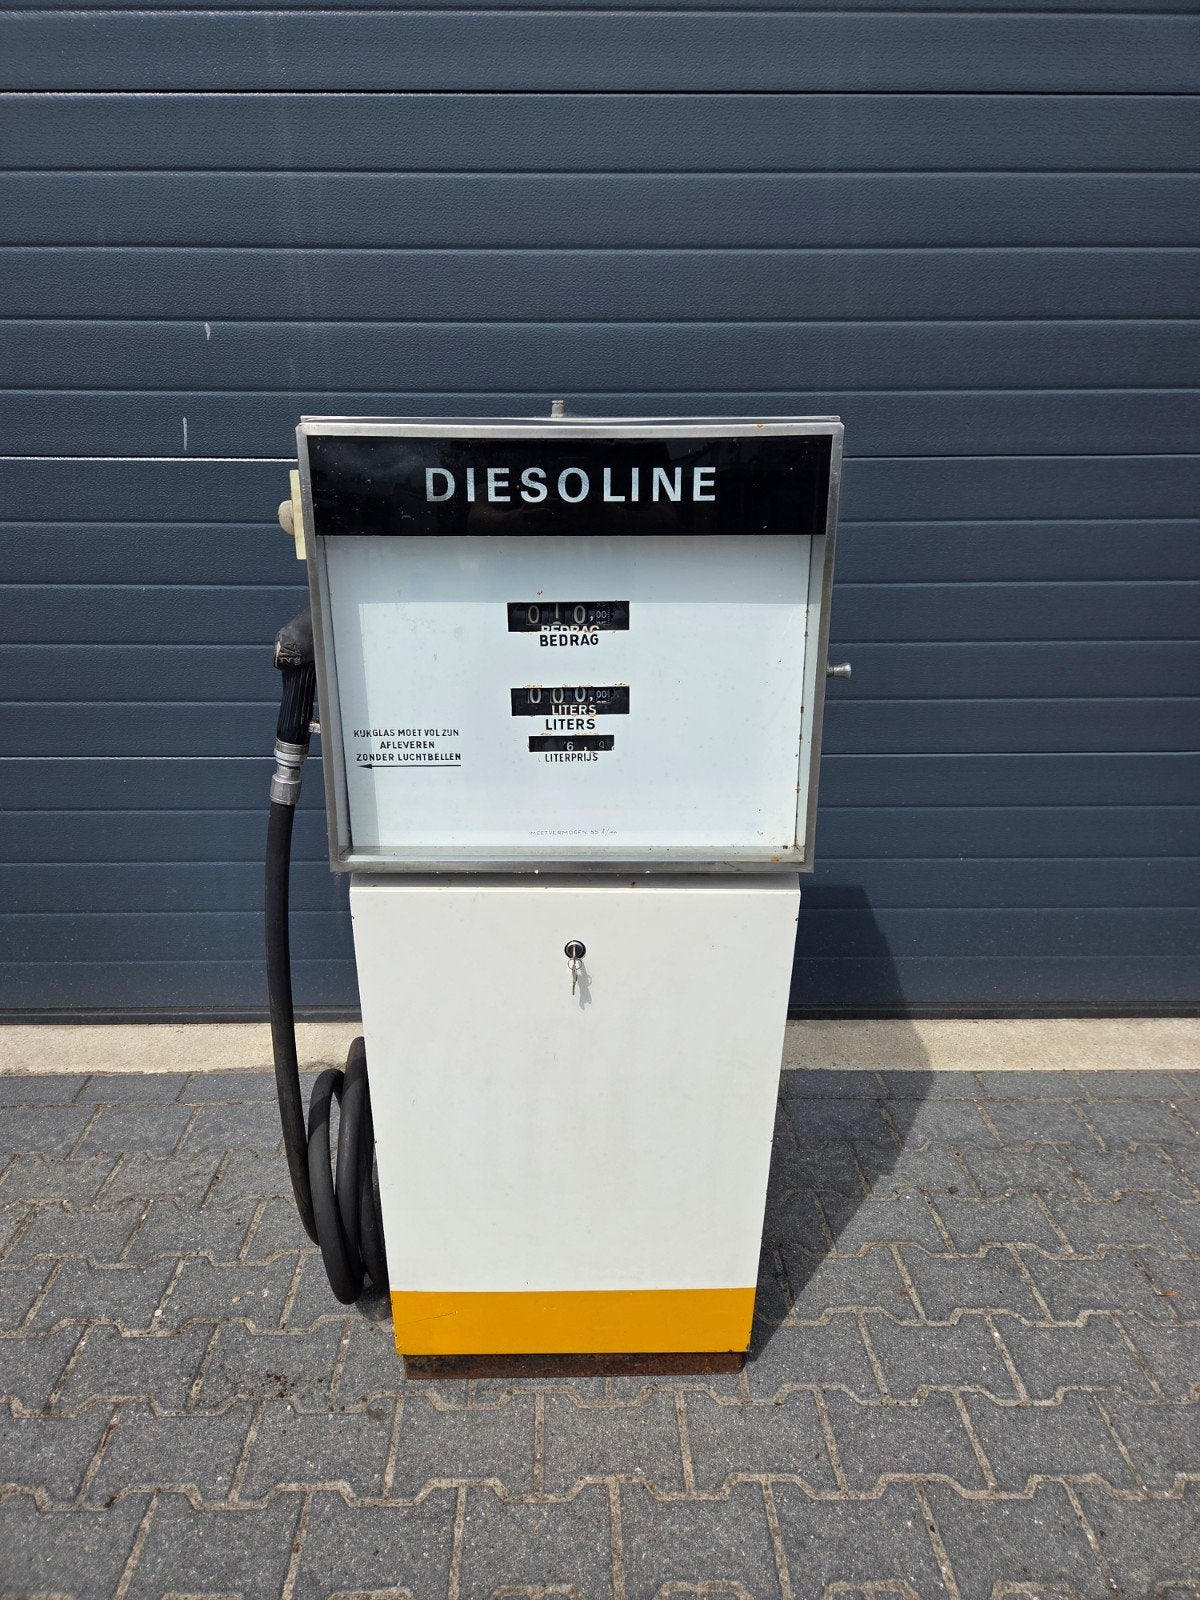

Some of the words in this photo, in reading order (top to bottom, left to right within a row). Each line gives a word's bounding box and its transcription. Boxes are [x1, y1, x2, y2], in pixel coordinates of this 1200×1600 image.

[425, 466, 716, 503] DIESOLINE
[540, 634, 599, 647] BEDRAG
[551, 705, 597, 715] LITERS
[545, 719, 596, 731] LITERS
[398, 729, 422, 737] MOET
[424, 729, 440, 737] VOL
[380, 741, 435, 749] AFLEVEREN
[356, 753, 395, 762] ZONDER
[397, 753, 461, 761] LUCHTBELLEN
[545, 752, 599, 763] LITERPRIJS
